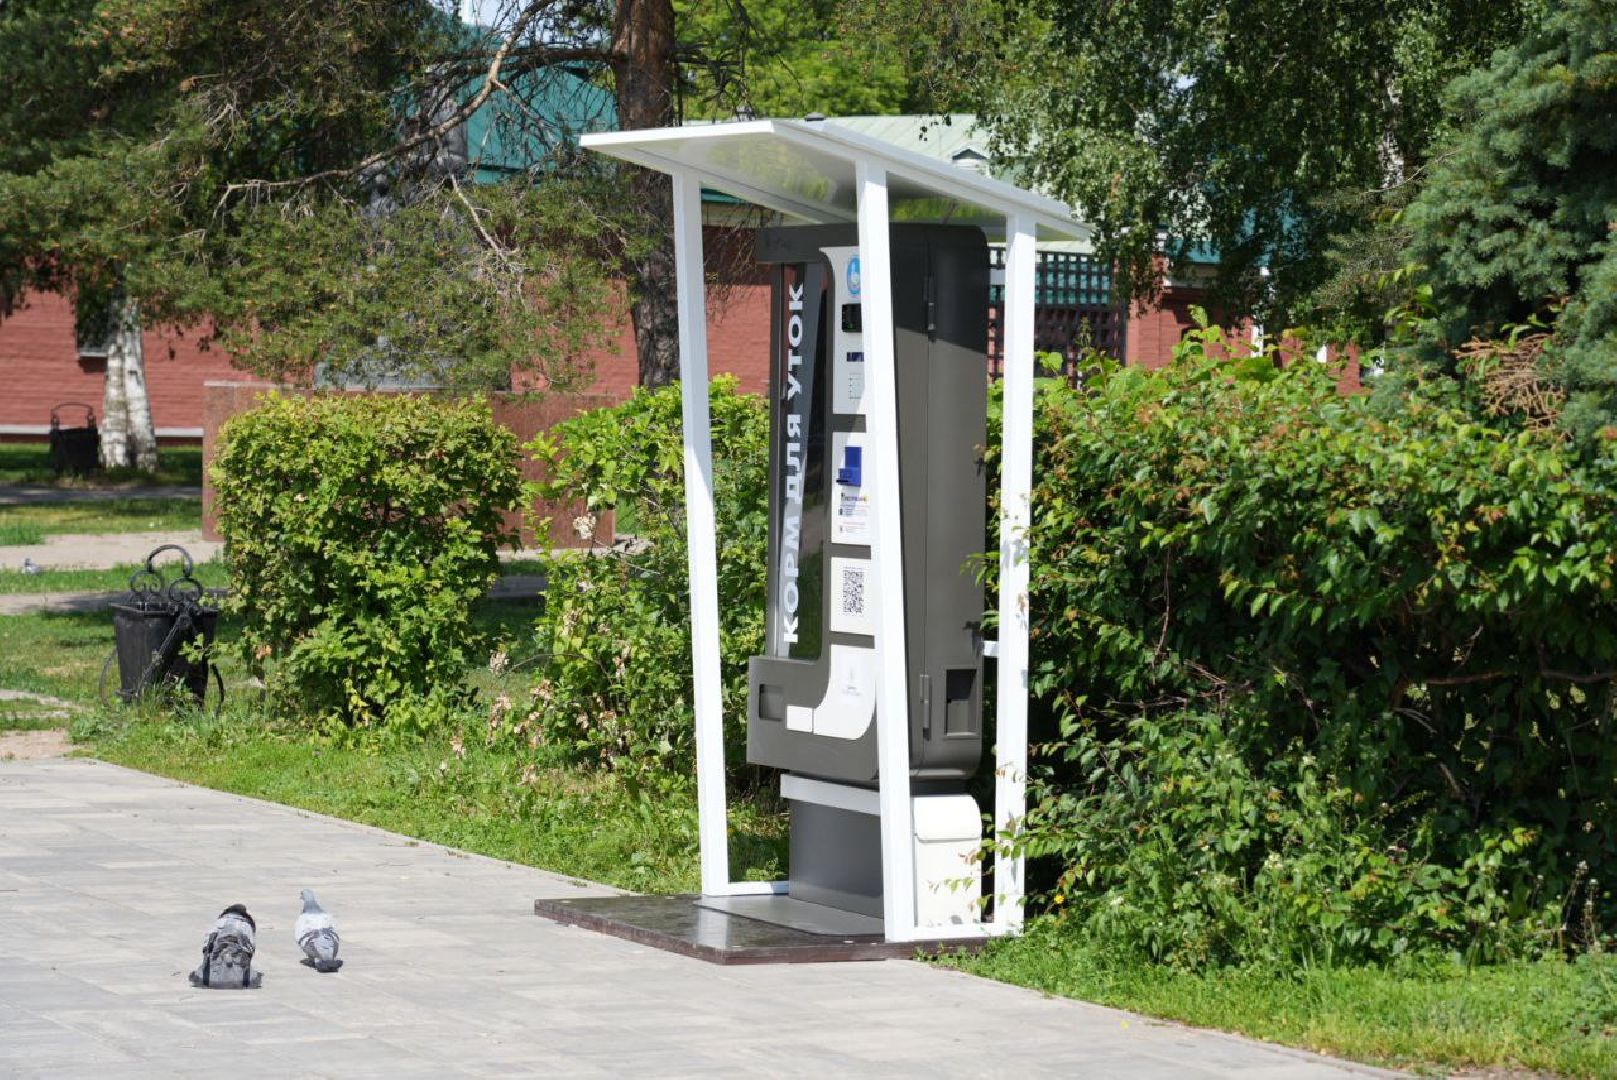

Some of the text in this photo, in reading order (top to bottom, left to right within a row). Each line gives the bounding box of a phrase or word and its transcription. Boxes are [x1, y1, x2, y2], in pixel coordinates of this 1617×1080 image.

[783, 283, 804, 643] КОРМ ДЛЯ УТОК
